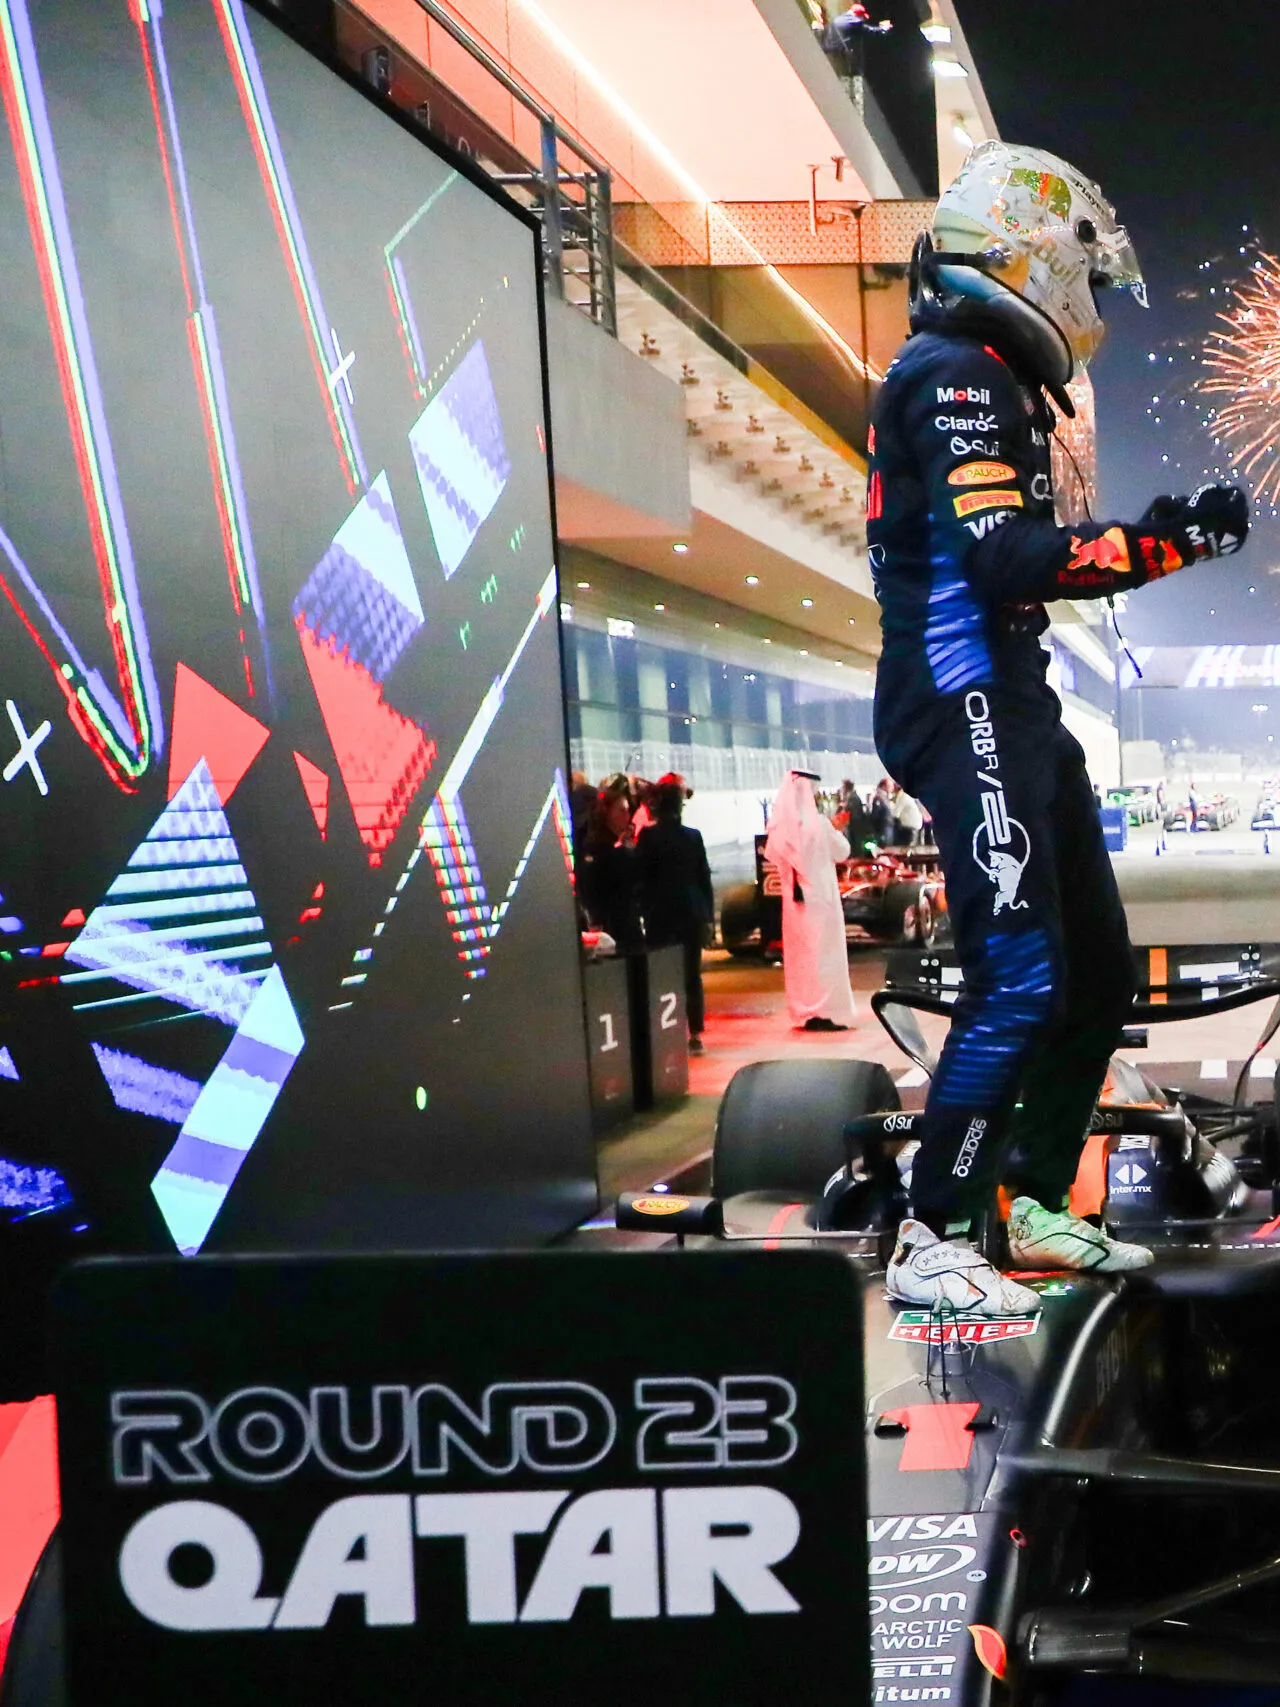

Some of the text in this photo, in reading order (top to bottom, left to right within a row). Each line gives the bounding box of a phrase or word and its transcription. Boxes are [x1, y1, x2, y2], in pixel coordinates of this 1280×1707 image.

[937, 387, 990, 404] Mobil
[972, 439, 999, 456] Sui
[965, 468, 1007, 480] RAUCH
[963, 510, 1017, 540] VIS
[660, 992, 678, 1029] 2
[599, 1013, 618, 1052] 1
[954, 1117, 987, 1177] sparco
[897, 1323, 1028, 1341] HEUER
[111, 1375, 799, 1483] ROUND 23
[867, 1515, 977, 1541] VISA
[119, 1486, 802, 1631] QATAR
[871, 1619, 963, 1636] ARCTIC
[882, 1634, 952, 1650] WOLF
[871, 1656, 956, 1679] ELLI
[872, 1685, 951, 1702] itum
